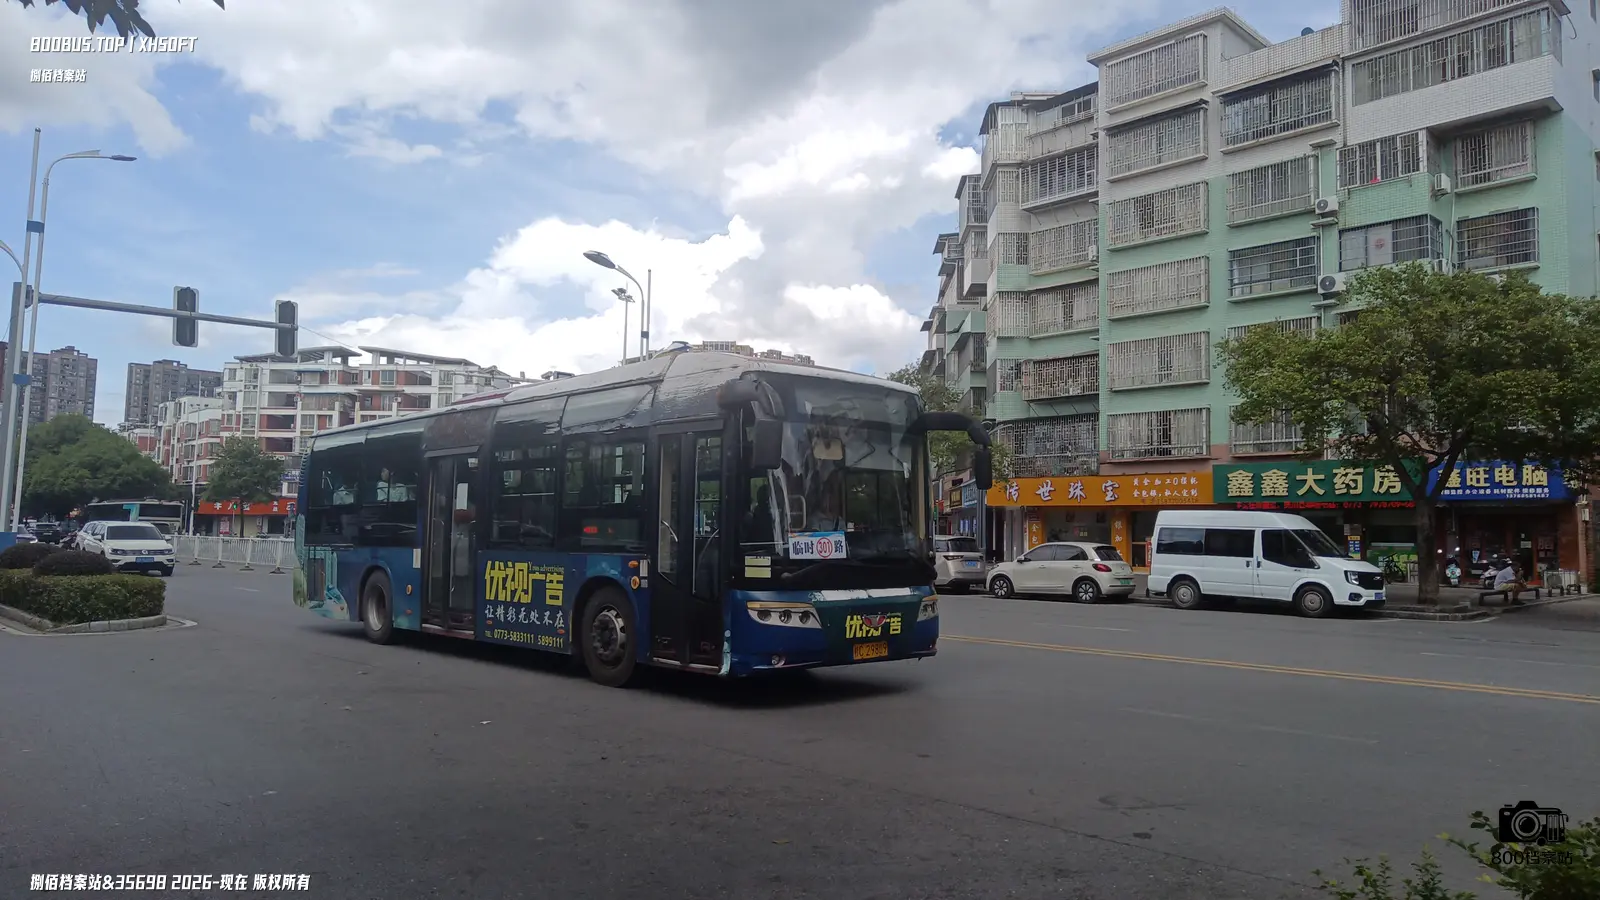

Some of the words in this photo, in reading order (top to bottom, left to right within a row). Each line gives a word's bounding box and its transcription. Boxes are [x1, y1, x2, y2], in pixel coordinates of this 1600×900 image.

[1227, 464, 1401, 497] 鑫鑫大药房
[485, 560, 564, 606] 优视广告
[484, 604, 565, 629] 让精彩无处不在
[494, 629, 534, 644] 0773-5833111
[537, 635, 564, 649] 5899111
